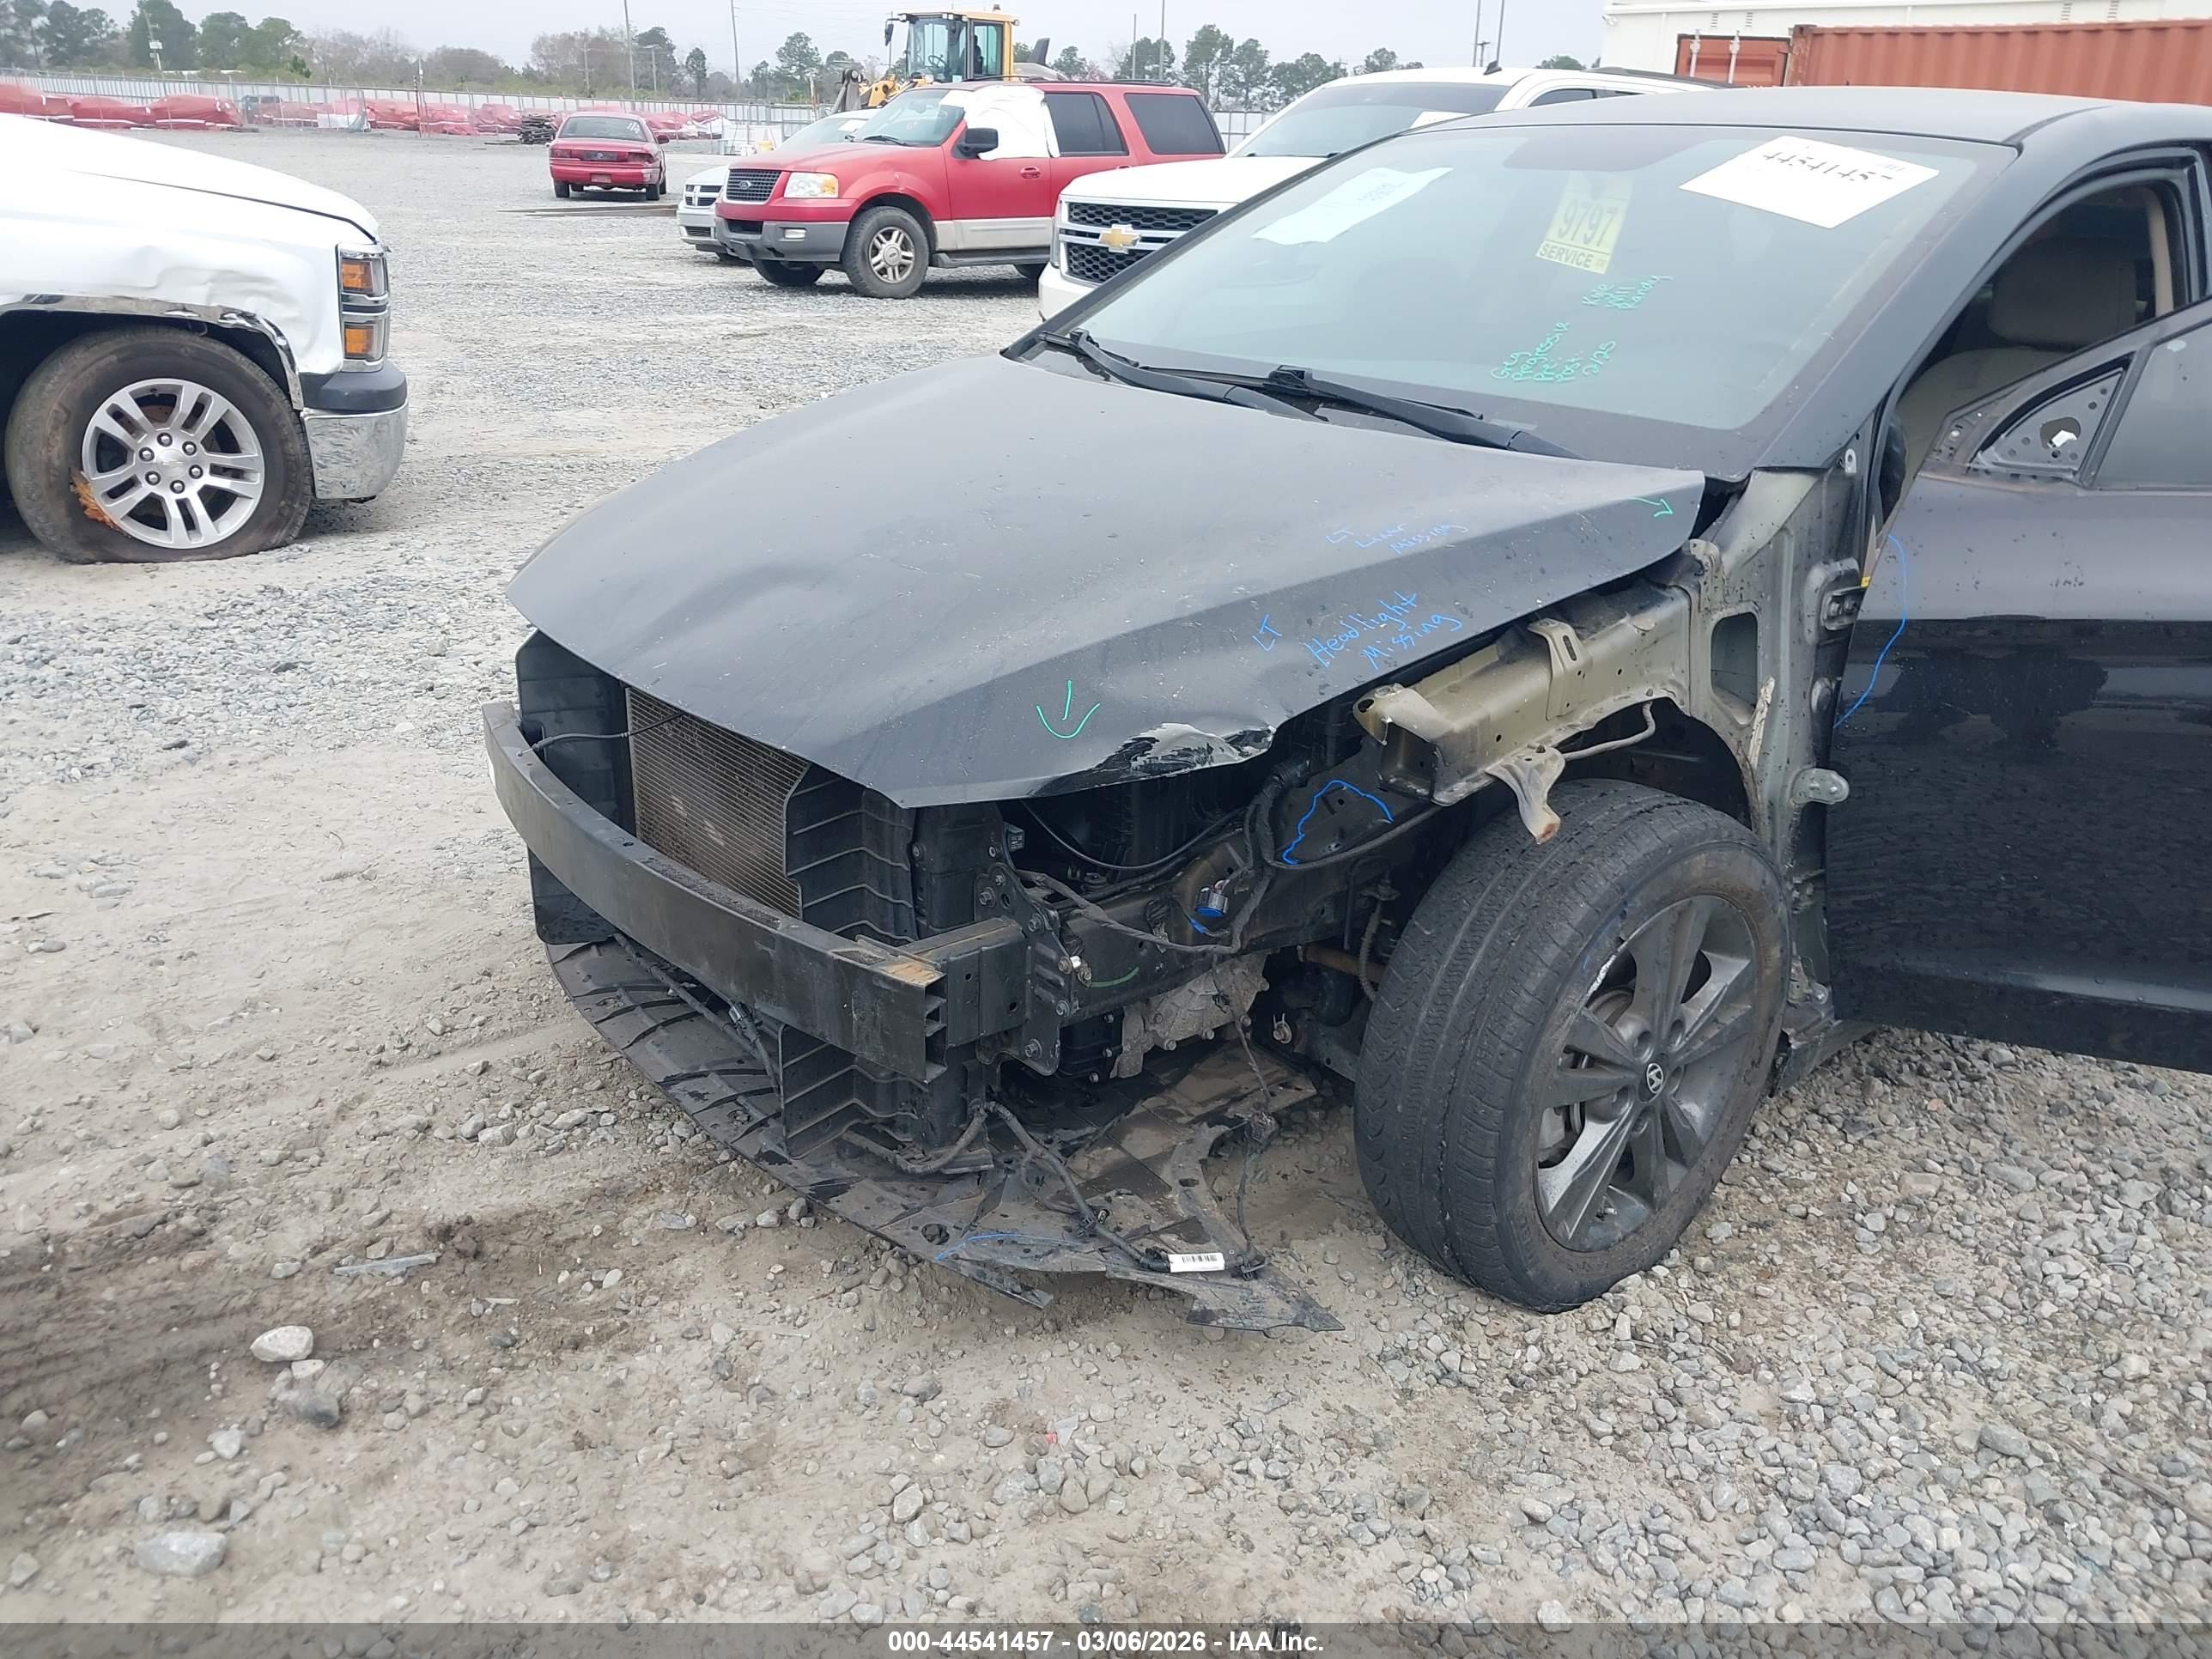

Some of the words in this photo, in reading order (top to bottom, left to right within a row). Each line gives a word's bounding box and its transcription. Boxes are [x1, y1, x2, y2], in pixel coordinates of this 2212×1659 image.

[1558, 199, 1619, 247] 9797
[1540, 243, 1595, 269] SERVICE
[1252, 614, 1283, 651] LT
